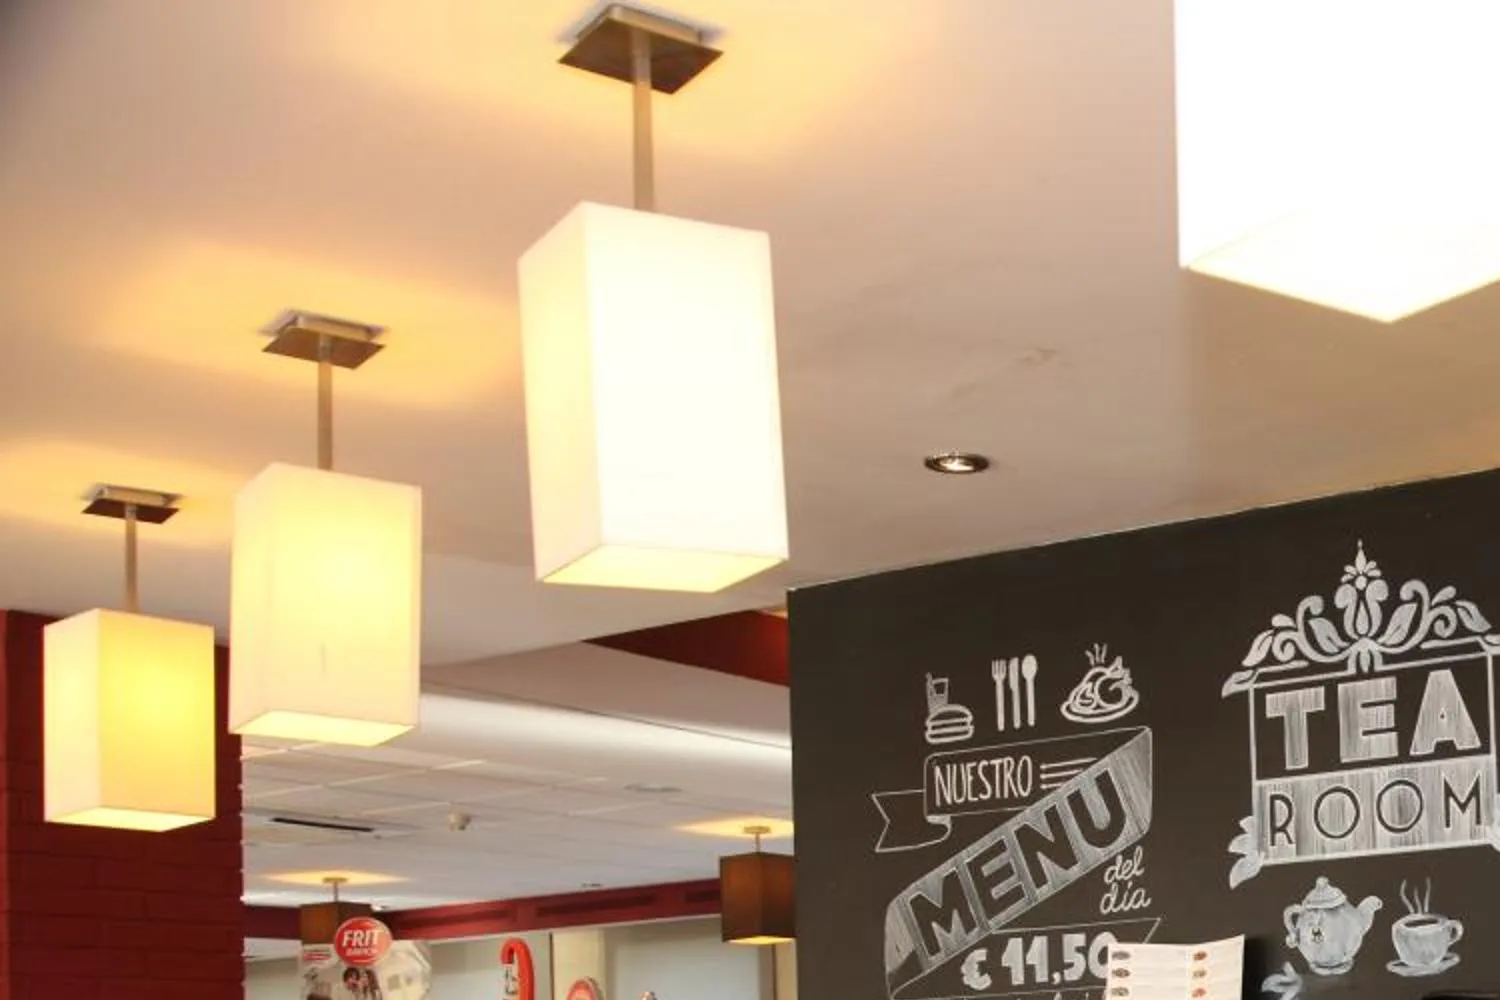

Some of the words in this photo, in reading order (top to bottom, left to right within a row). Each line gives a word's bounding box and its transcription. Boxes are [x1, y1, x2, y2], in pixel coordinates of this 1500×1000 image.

[1265, 668, 1482, 770] TEA
[933, 754, 1034, 806] NUESTRO
[1269, 771, 1482, 848] ROOM
[908, 773, 1127, 962] MENU
[1103, 846, 1145, 884] del
[341, 928, 381, 948] FRIT
